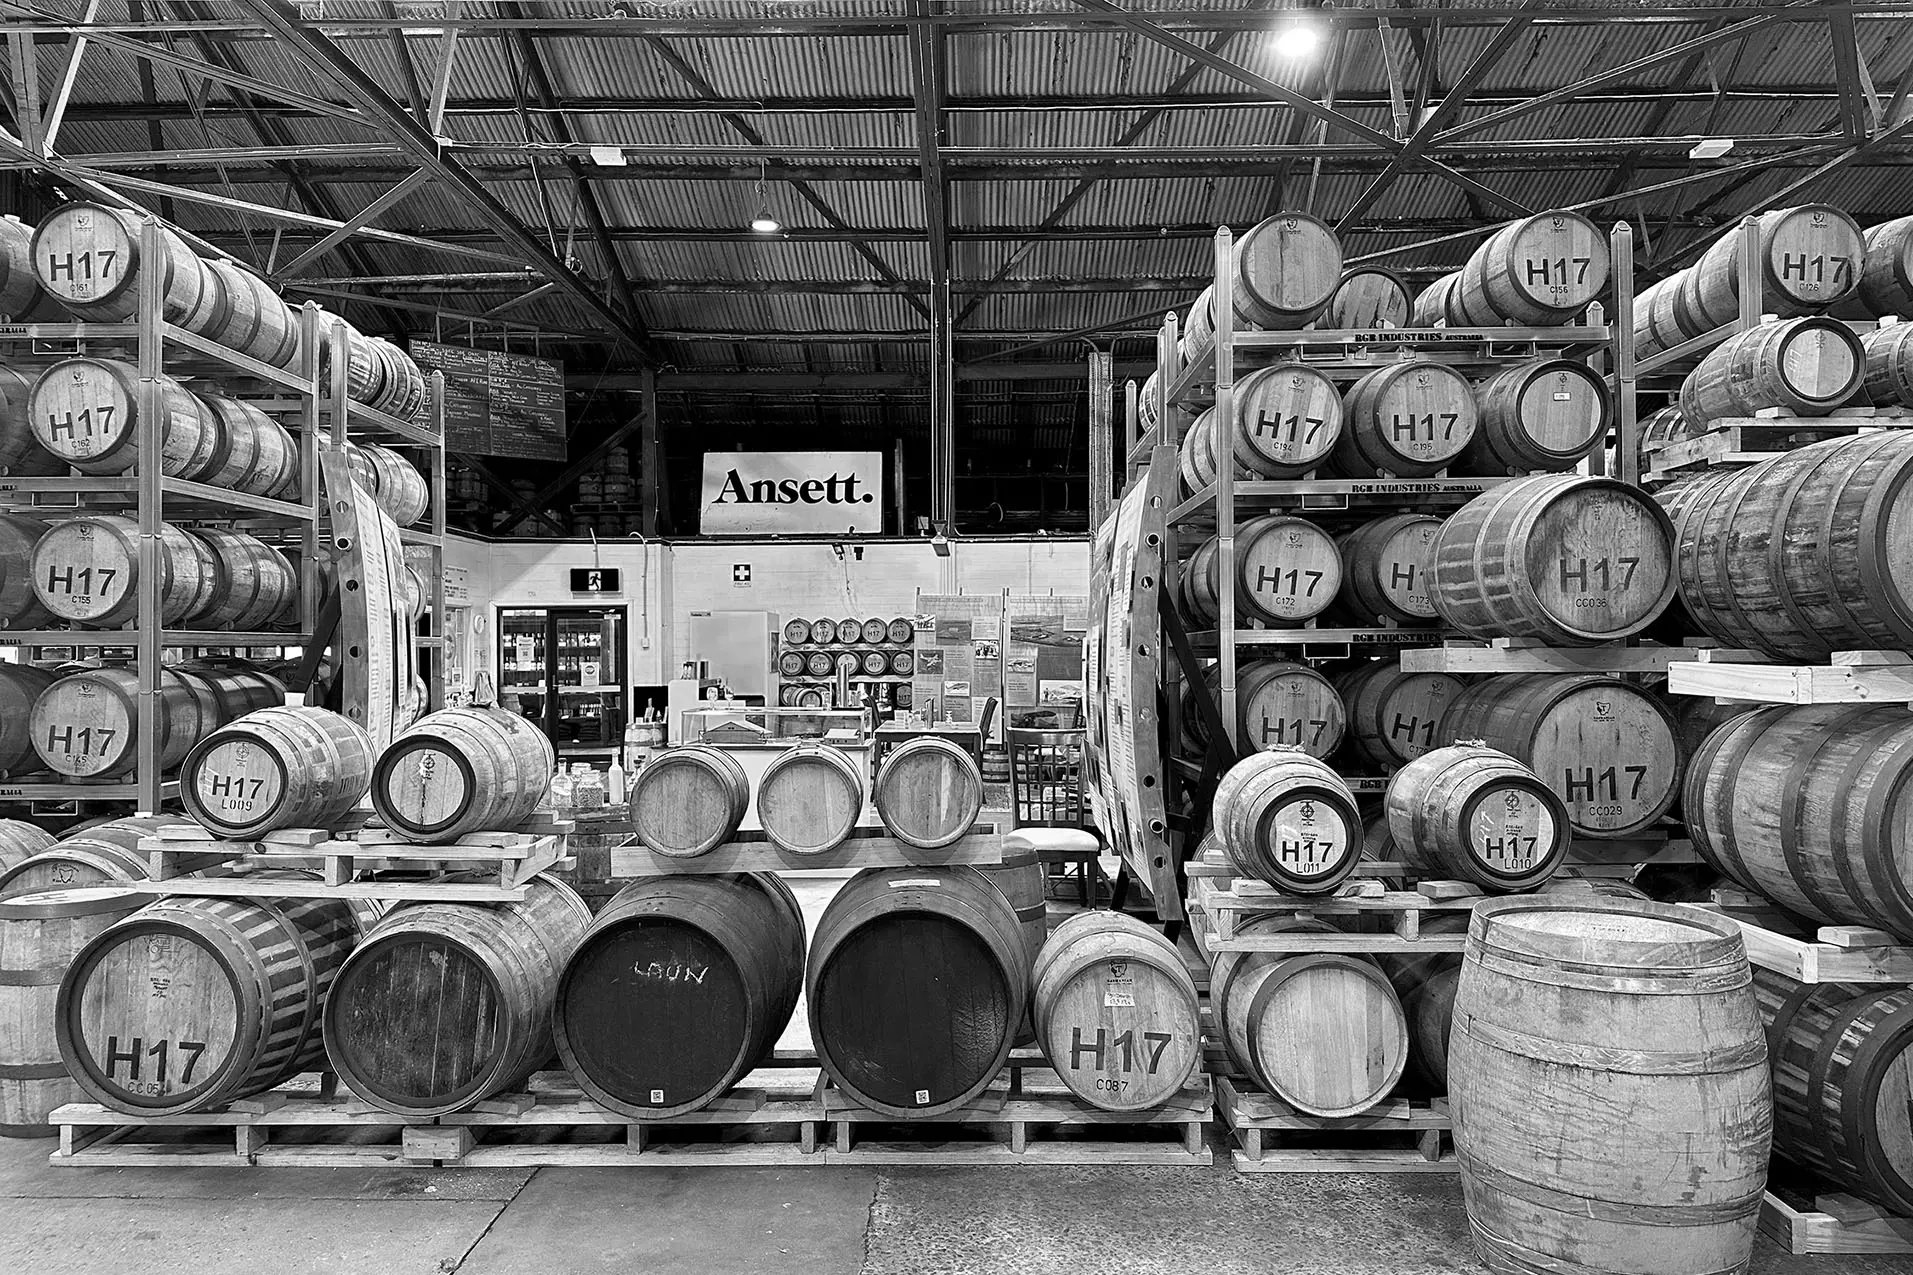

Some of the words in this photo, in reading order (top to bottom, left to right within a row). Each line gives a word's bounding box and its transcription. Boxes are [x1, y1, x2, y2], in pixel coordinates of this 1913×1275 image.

[50, 251, 116, 281] H17
[1527, 258, 1590, 285] H17
[1783, 253, 1848, 283] H17
[1380, 333, 1441, 341] INDUSTRIES
[50, 406, 115, 441] H17
[1256, 410, 1324, 444] H17
[1394, 414, 1458, 441] H17
[711, 469, 873, 504] Ansett.
[1376, 484, 1440, 492] INDUSTRIES
[48, 566, 116, 596] H17
[1257, 566, 1323, 597] H17
[1560, 557, 1640, 592] H17
[1275, 597, 1295, 606] C172
[48, 725, 116, 756] H17
[1262, 717, 1327, 746] H17
[212, 775, 264, 799] H17
[1565, 766, 1647, 802] H17
[1282, 841, 1333, 862] H17
[1486, 837, 1537, 859] H17
[106, 1036, 206, 1084] H17
[1071, 1027, 1171, 1074] H17
[1096, 1079, 1128, 1091] C087
